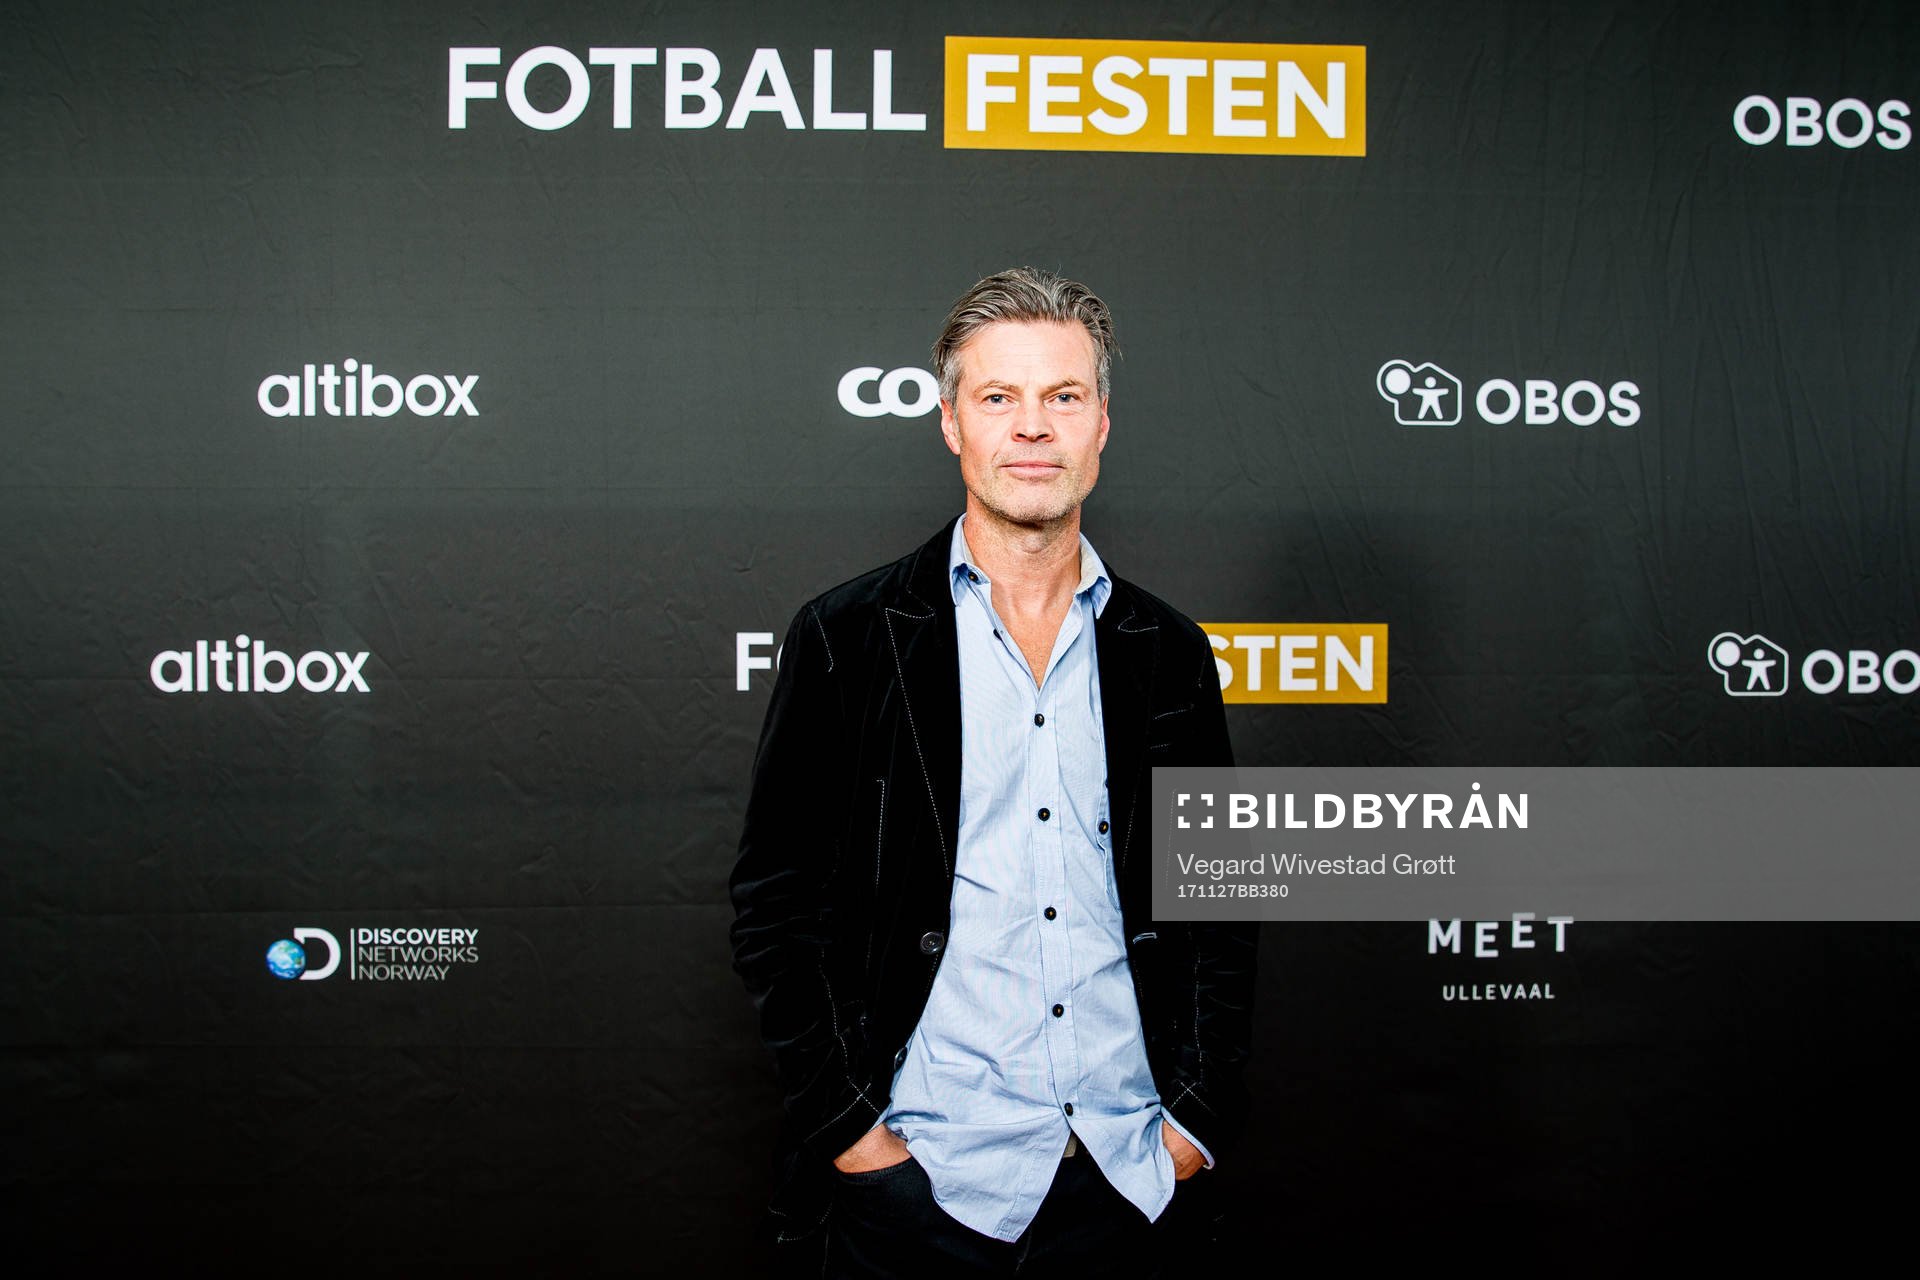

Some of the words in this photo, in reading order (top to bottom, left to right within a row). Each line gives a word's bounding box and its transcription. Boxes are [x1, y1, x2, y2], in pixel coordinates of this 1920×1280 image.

[448, 45, 927, 131] FOTBALL
[966, 53, 1346, 139] FESTEN
[1733, 95, 1911, 150] OBOS
[257, 357, 480, 418] altibox
[1476, 378, 1641, 427] OBOS
[150, 634, 371, 693] altibox
[358, 928, 479, 945] DISCOVERY
[358, 946, 479, 963] NETWORKS
[1428, 912, 1575, 958] MEET
[358, 964, 450, 981] NORWAY
[1442, 983, 1556, 1001] ULLEVAAL
